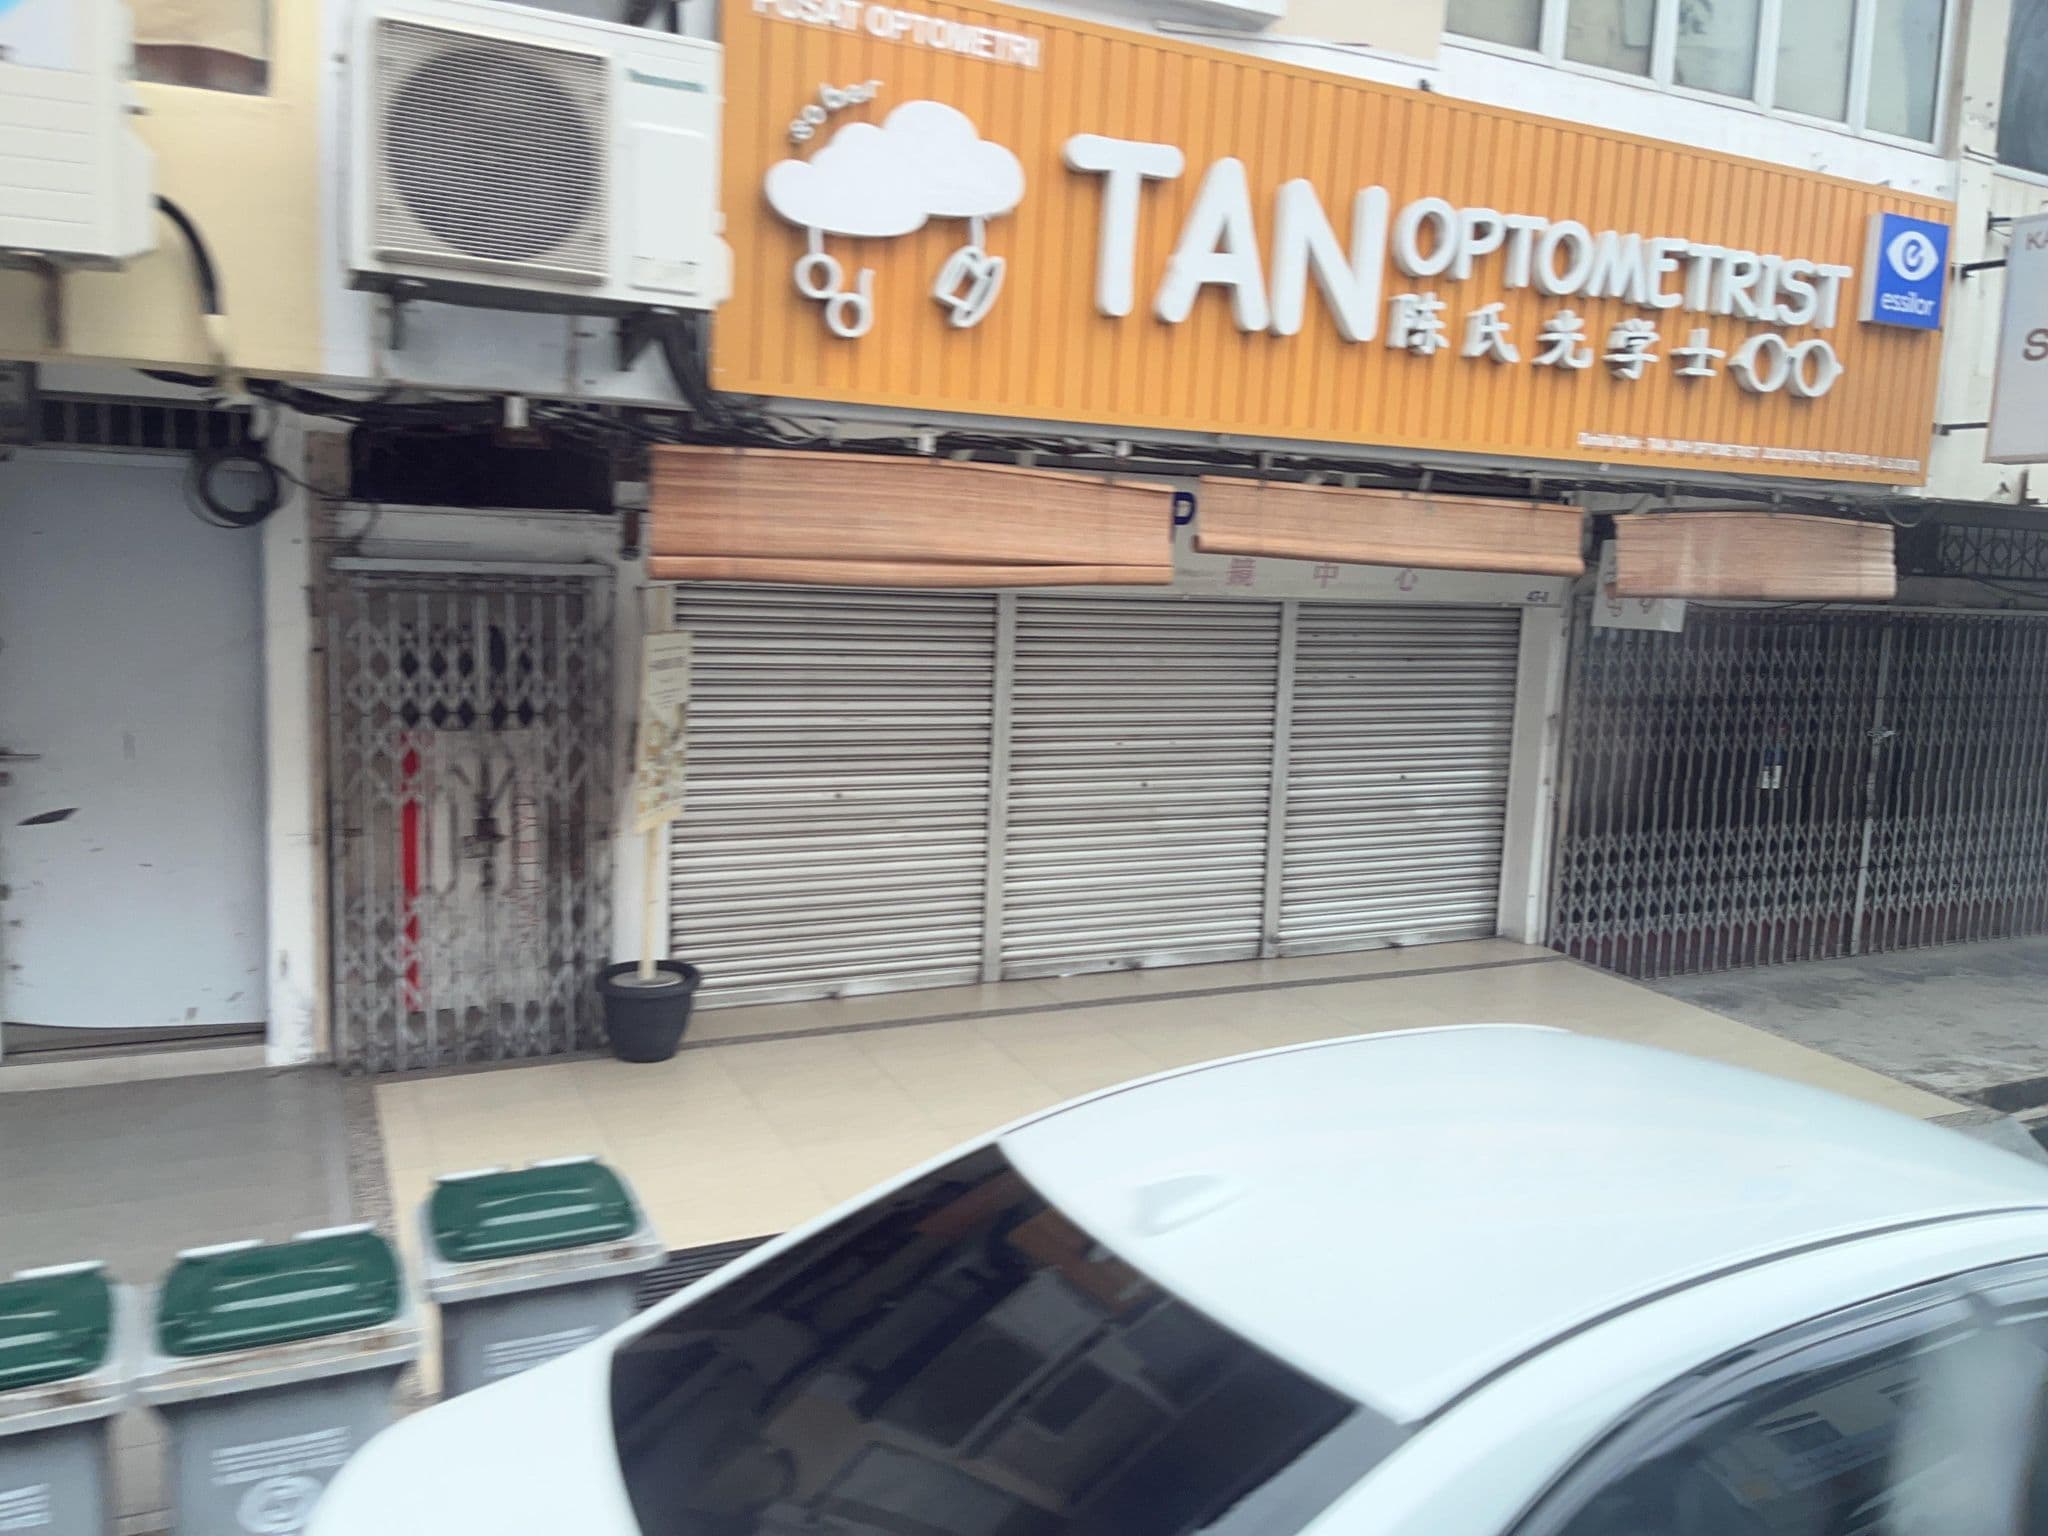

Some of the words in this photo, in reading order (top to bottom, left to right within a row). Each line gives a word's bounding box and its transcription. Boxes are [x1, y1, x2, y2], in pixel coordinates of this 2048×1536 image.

[1063, 133, 1391, 343] TAN
[1393, 196, 1853, 329] OPTOMETRIST
[1880, 292, 1935, 316] essilor
